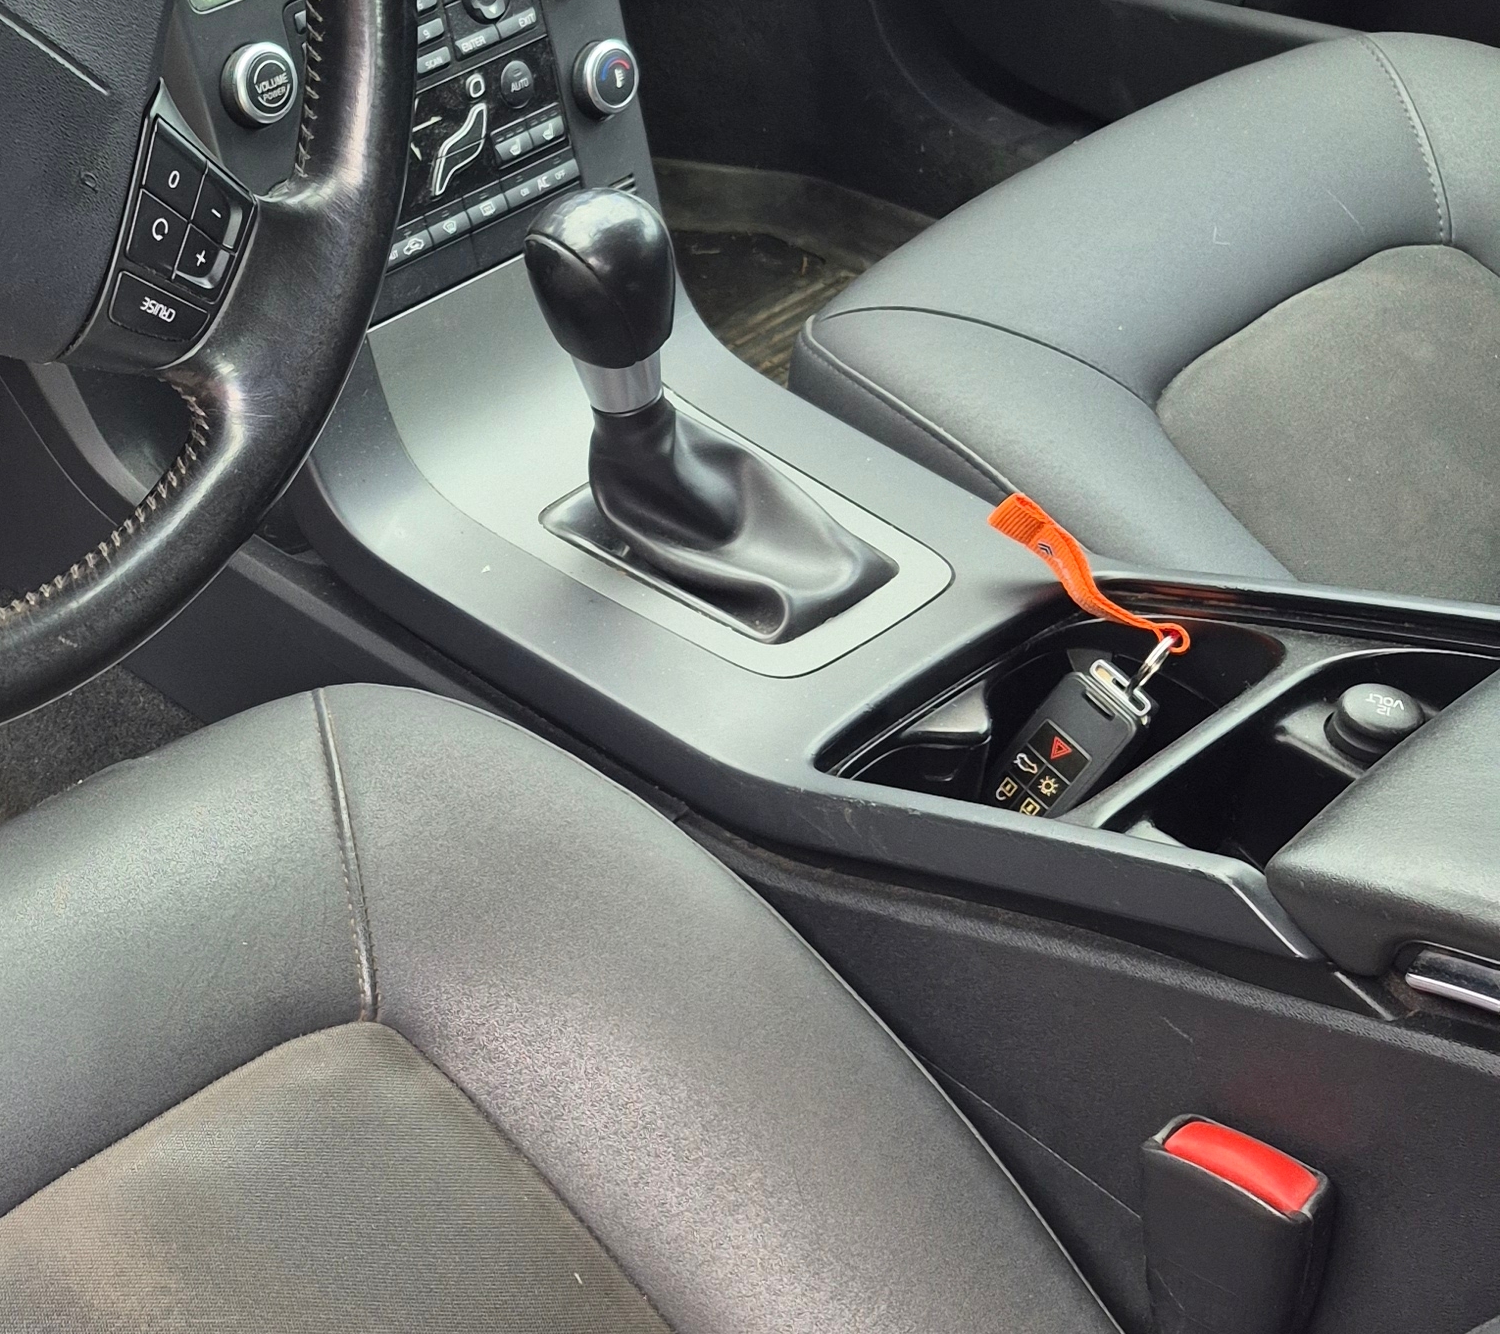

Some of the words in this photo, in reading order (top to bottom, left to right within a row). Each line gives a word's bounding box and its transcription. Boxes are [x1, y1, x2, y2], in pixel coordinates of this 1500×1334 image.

[518, 13, 536, 28] EXIT
[422, 29, 431, 40] 9
[461, 36, 487, 52] ENTER
[424, 56, 443, 70] SCAN
[254, 72, 289, 94] VOLUME
[510, 77, 530, 93] AUTO
[262, 84, 286, 101] POWER
[536, 175, 551, 193] AC
[139, 296, 176, 323] CRUISE
[1365, 693, 1405, 711] VOLT
[1376, 704, 1392, 717] 12
